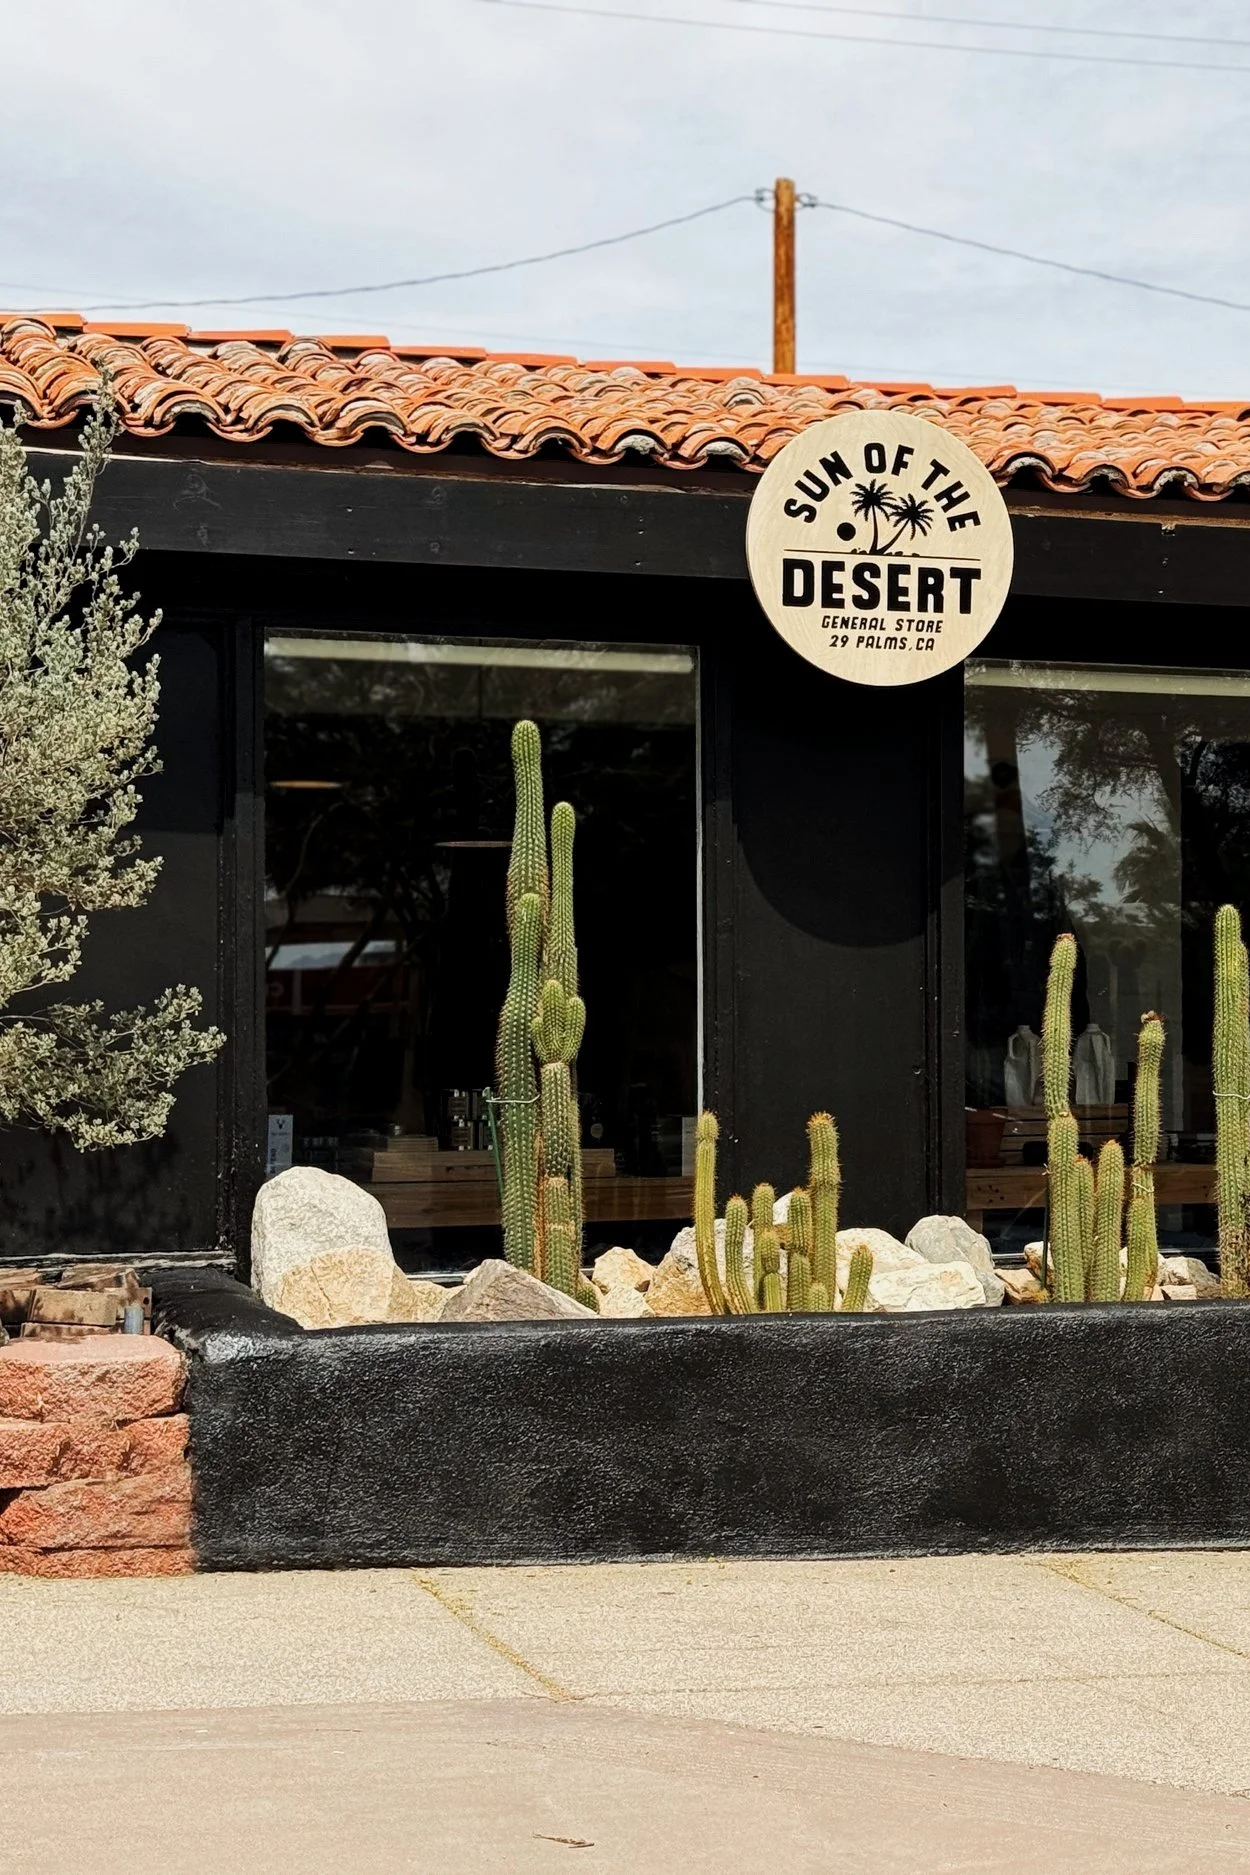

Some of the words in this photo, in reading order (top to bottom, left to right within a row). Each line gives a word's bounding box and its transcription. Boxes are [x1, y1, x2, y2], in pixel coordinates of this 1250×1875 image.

[784, 451, 853, 523] SUN
[864, 442, 915, 477] OF
[921, 458, 981, 532] THE
[782, 558, 982, 614] DESERT
[821, 615, 886, 631] GENERAL
[895, 618, 943, 633] STORE
[829, 634, 849, 648] 29
